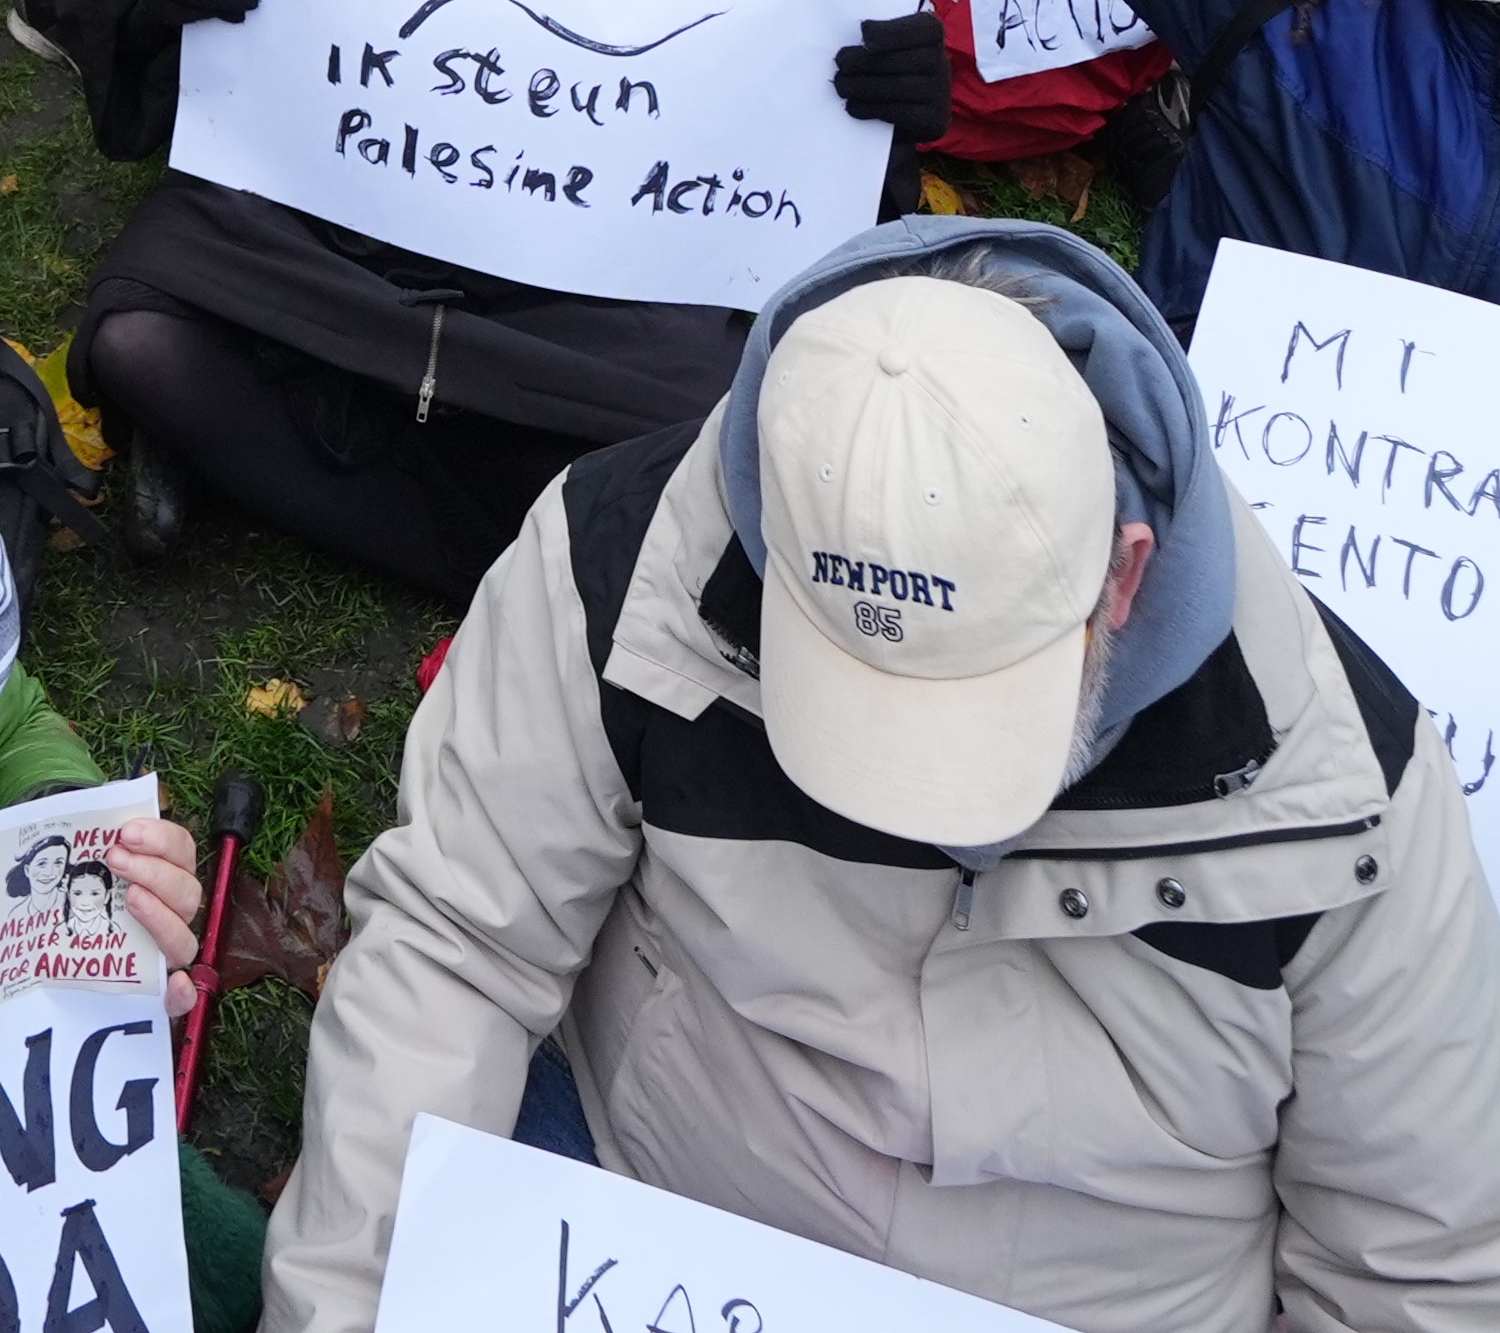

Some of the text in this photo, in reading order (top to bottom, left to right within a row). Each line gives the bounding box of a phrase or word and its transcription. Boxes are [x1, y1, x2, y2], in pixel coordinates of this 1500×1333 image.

[629, 159, 804, 230] Action
[811, 550, 957, 613] NEWPORT
[854, 600, 904, 643] 85
[0, 908, 61, 941] MEANS
[0, 932, 128, 964] NEVER AGAIN
[0, 951, 138, 987] FOR ANYONE
